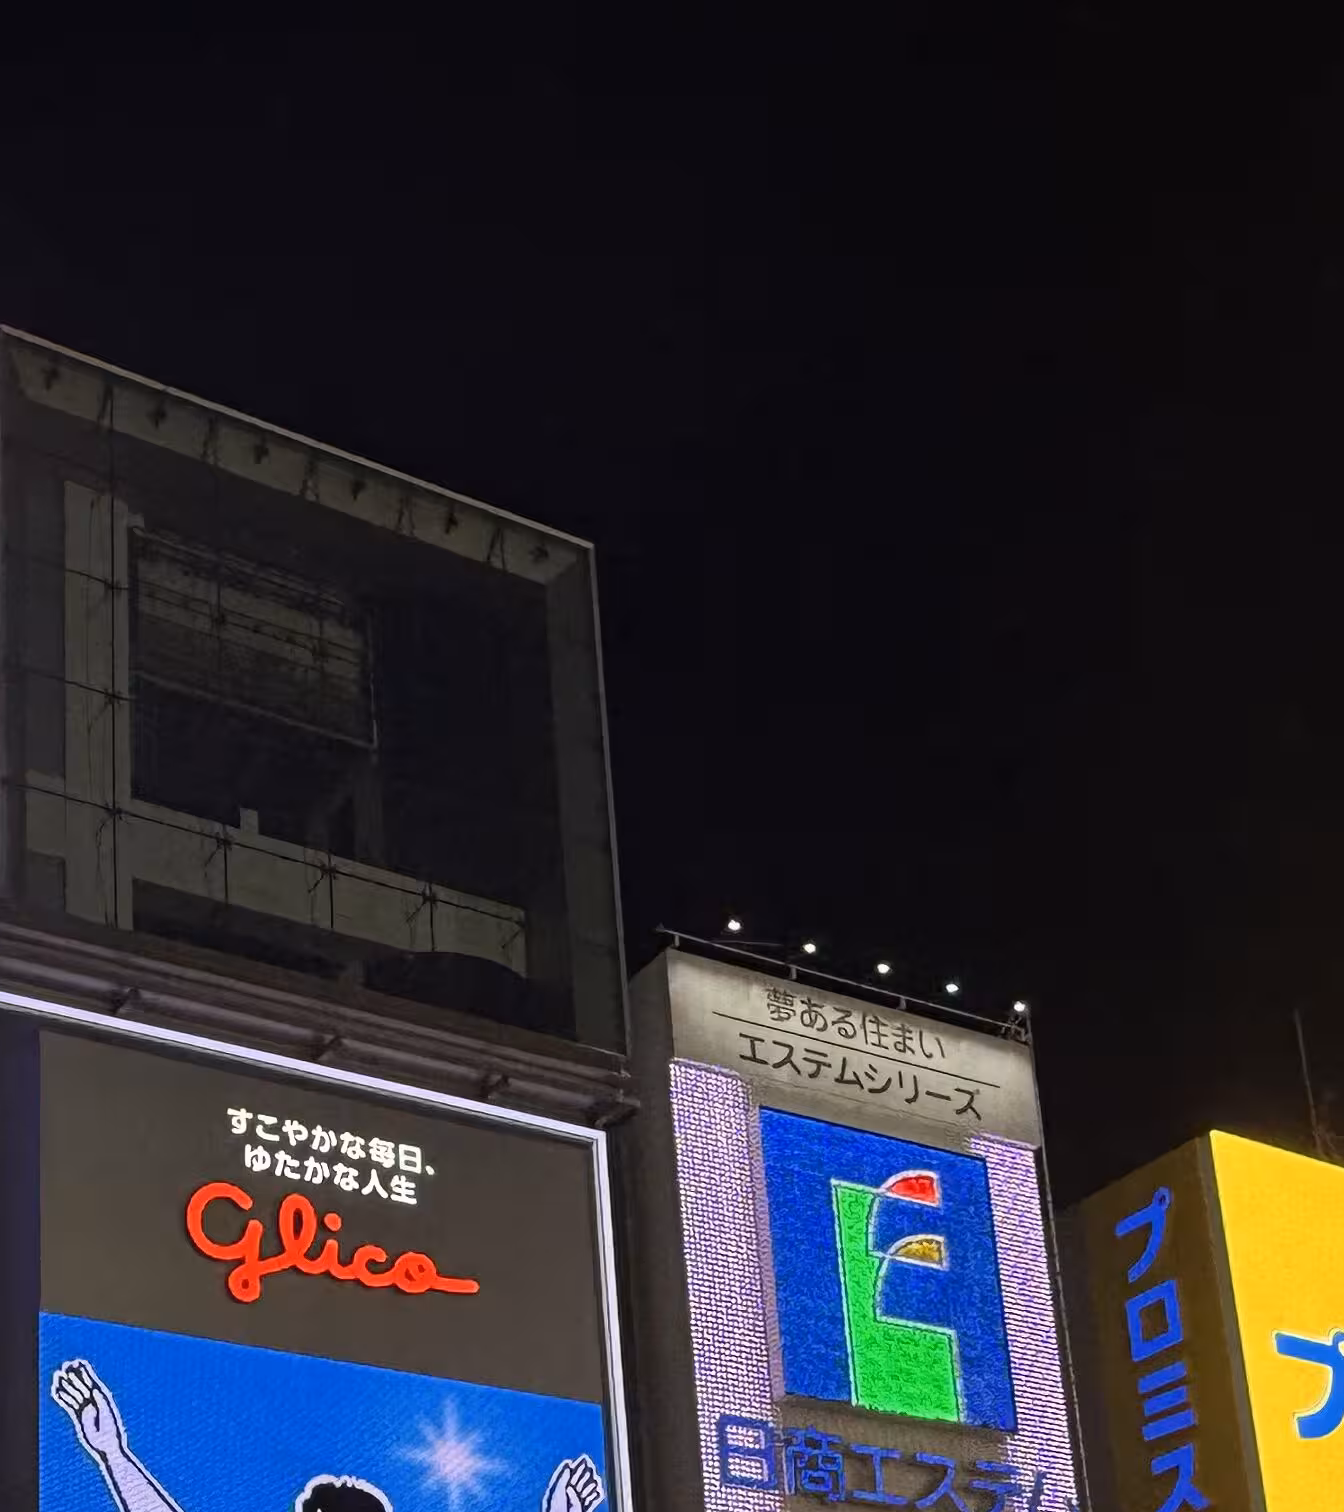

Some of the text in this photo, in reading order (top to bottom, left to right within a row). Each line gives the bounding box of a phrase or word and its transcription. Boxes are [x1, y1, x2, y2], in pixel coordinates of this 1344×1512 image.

[765, 986, 947, 1062] 夢ある住まい
[738, 1031, 983, 1121] エステムシリーズ
[226, 1108, 436, 1176] すこやかな毎日、
[243, 1143, 418, 1205] ゆたかな人生
[187, 1182, 481, 1303] Glico
